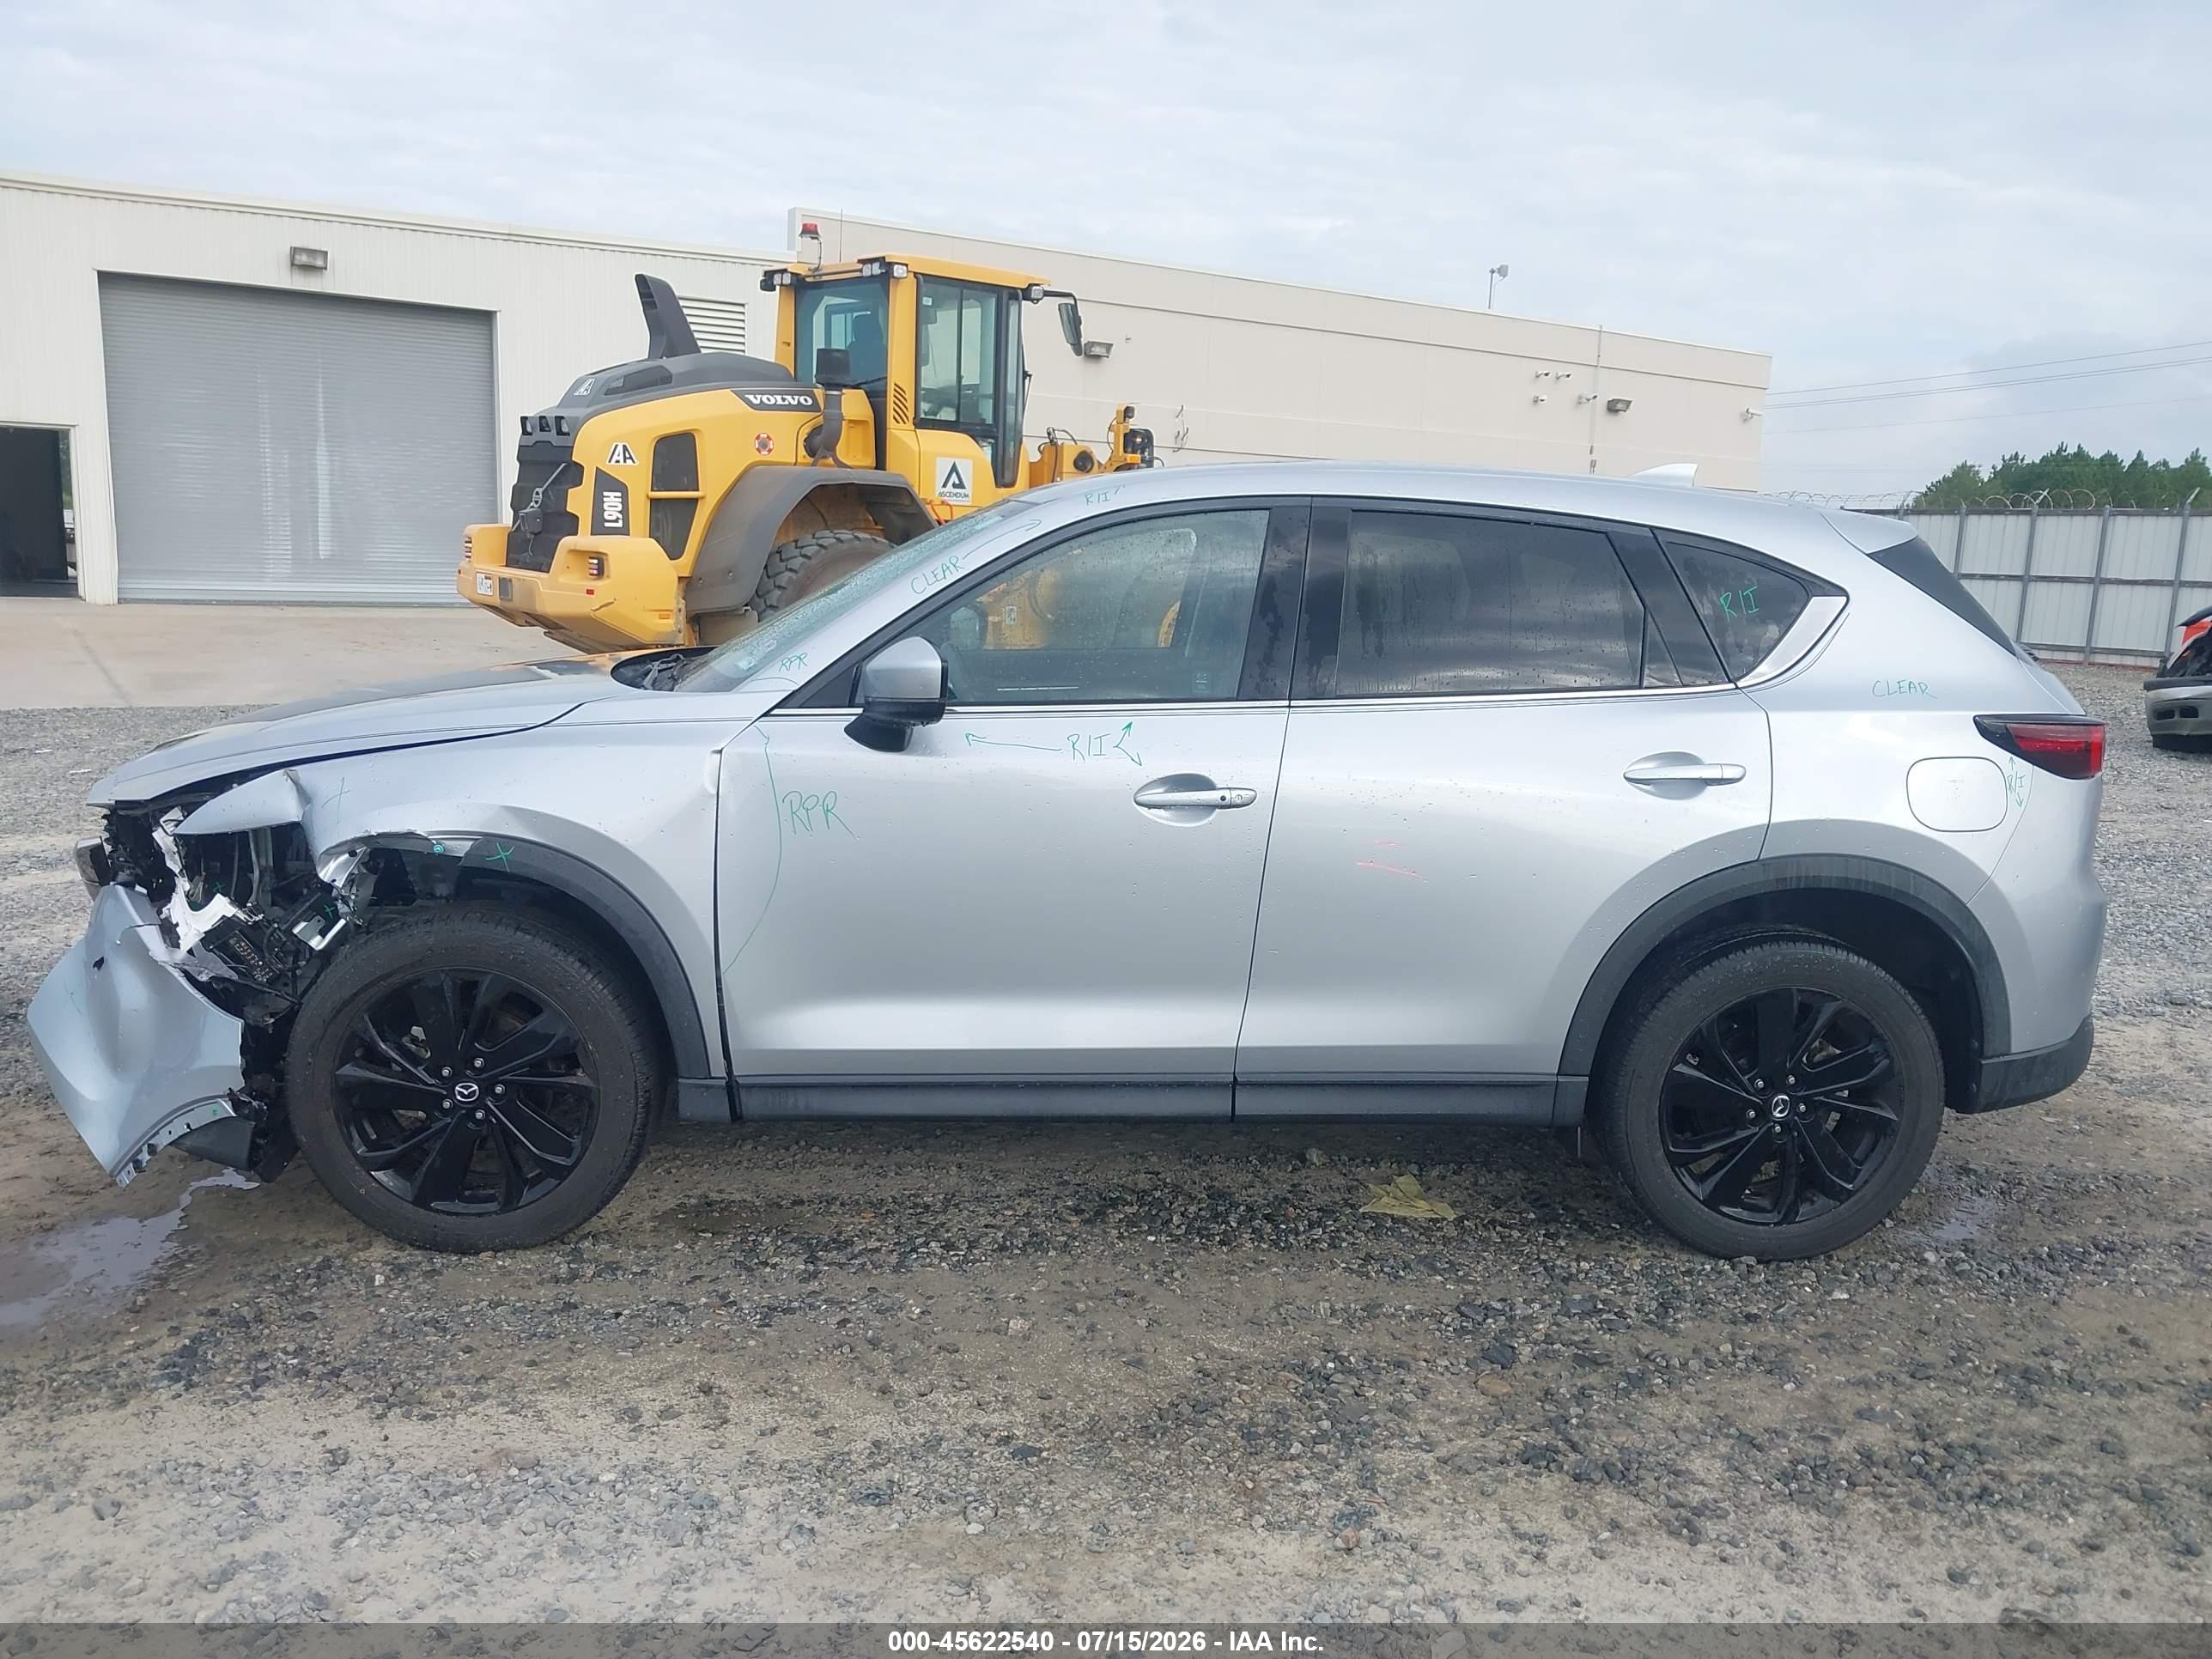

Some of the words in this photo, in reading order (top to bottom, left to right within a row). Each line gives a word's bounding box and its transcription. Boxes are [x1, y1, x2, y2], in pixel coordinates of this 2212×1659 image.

[744, 394, 813, 406] VOLVO
[603, 491, 623, 528] L90H
[910, 556, 965, 594] CLEAR
[1872, 679, 1938, 700] CLEAR
[781, 790, 857, 837] RPR
